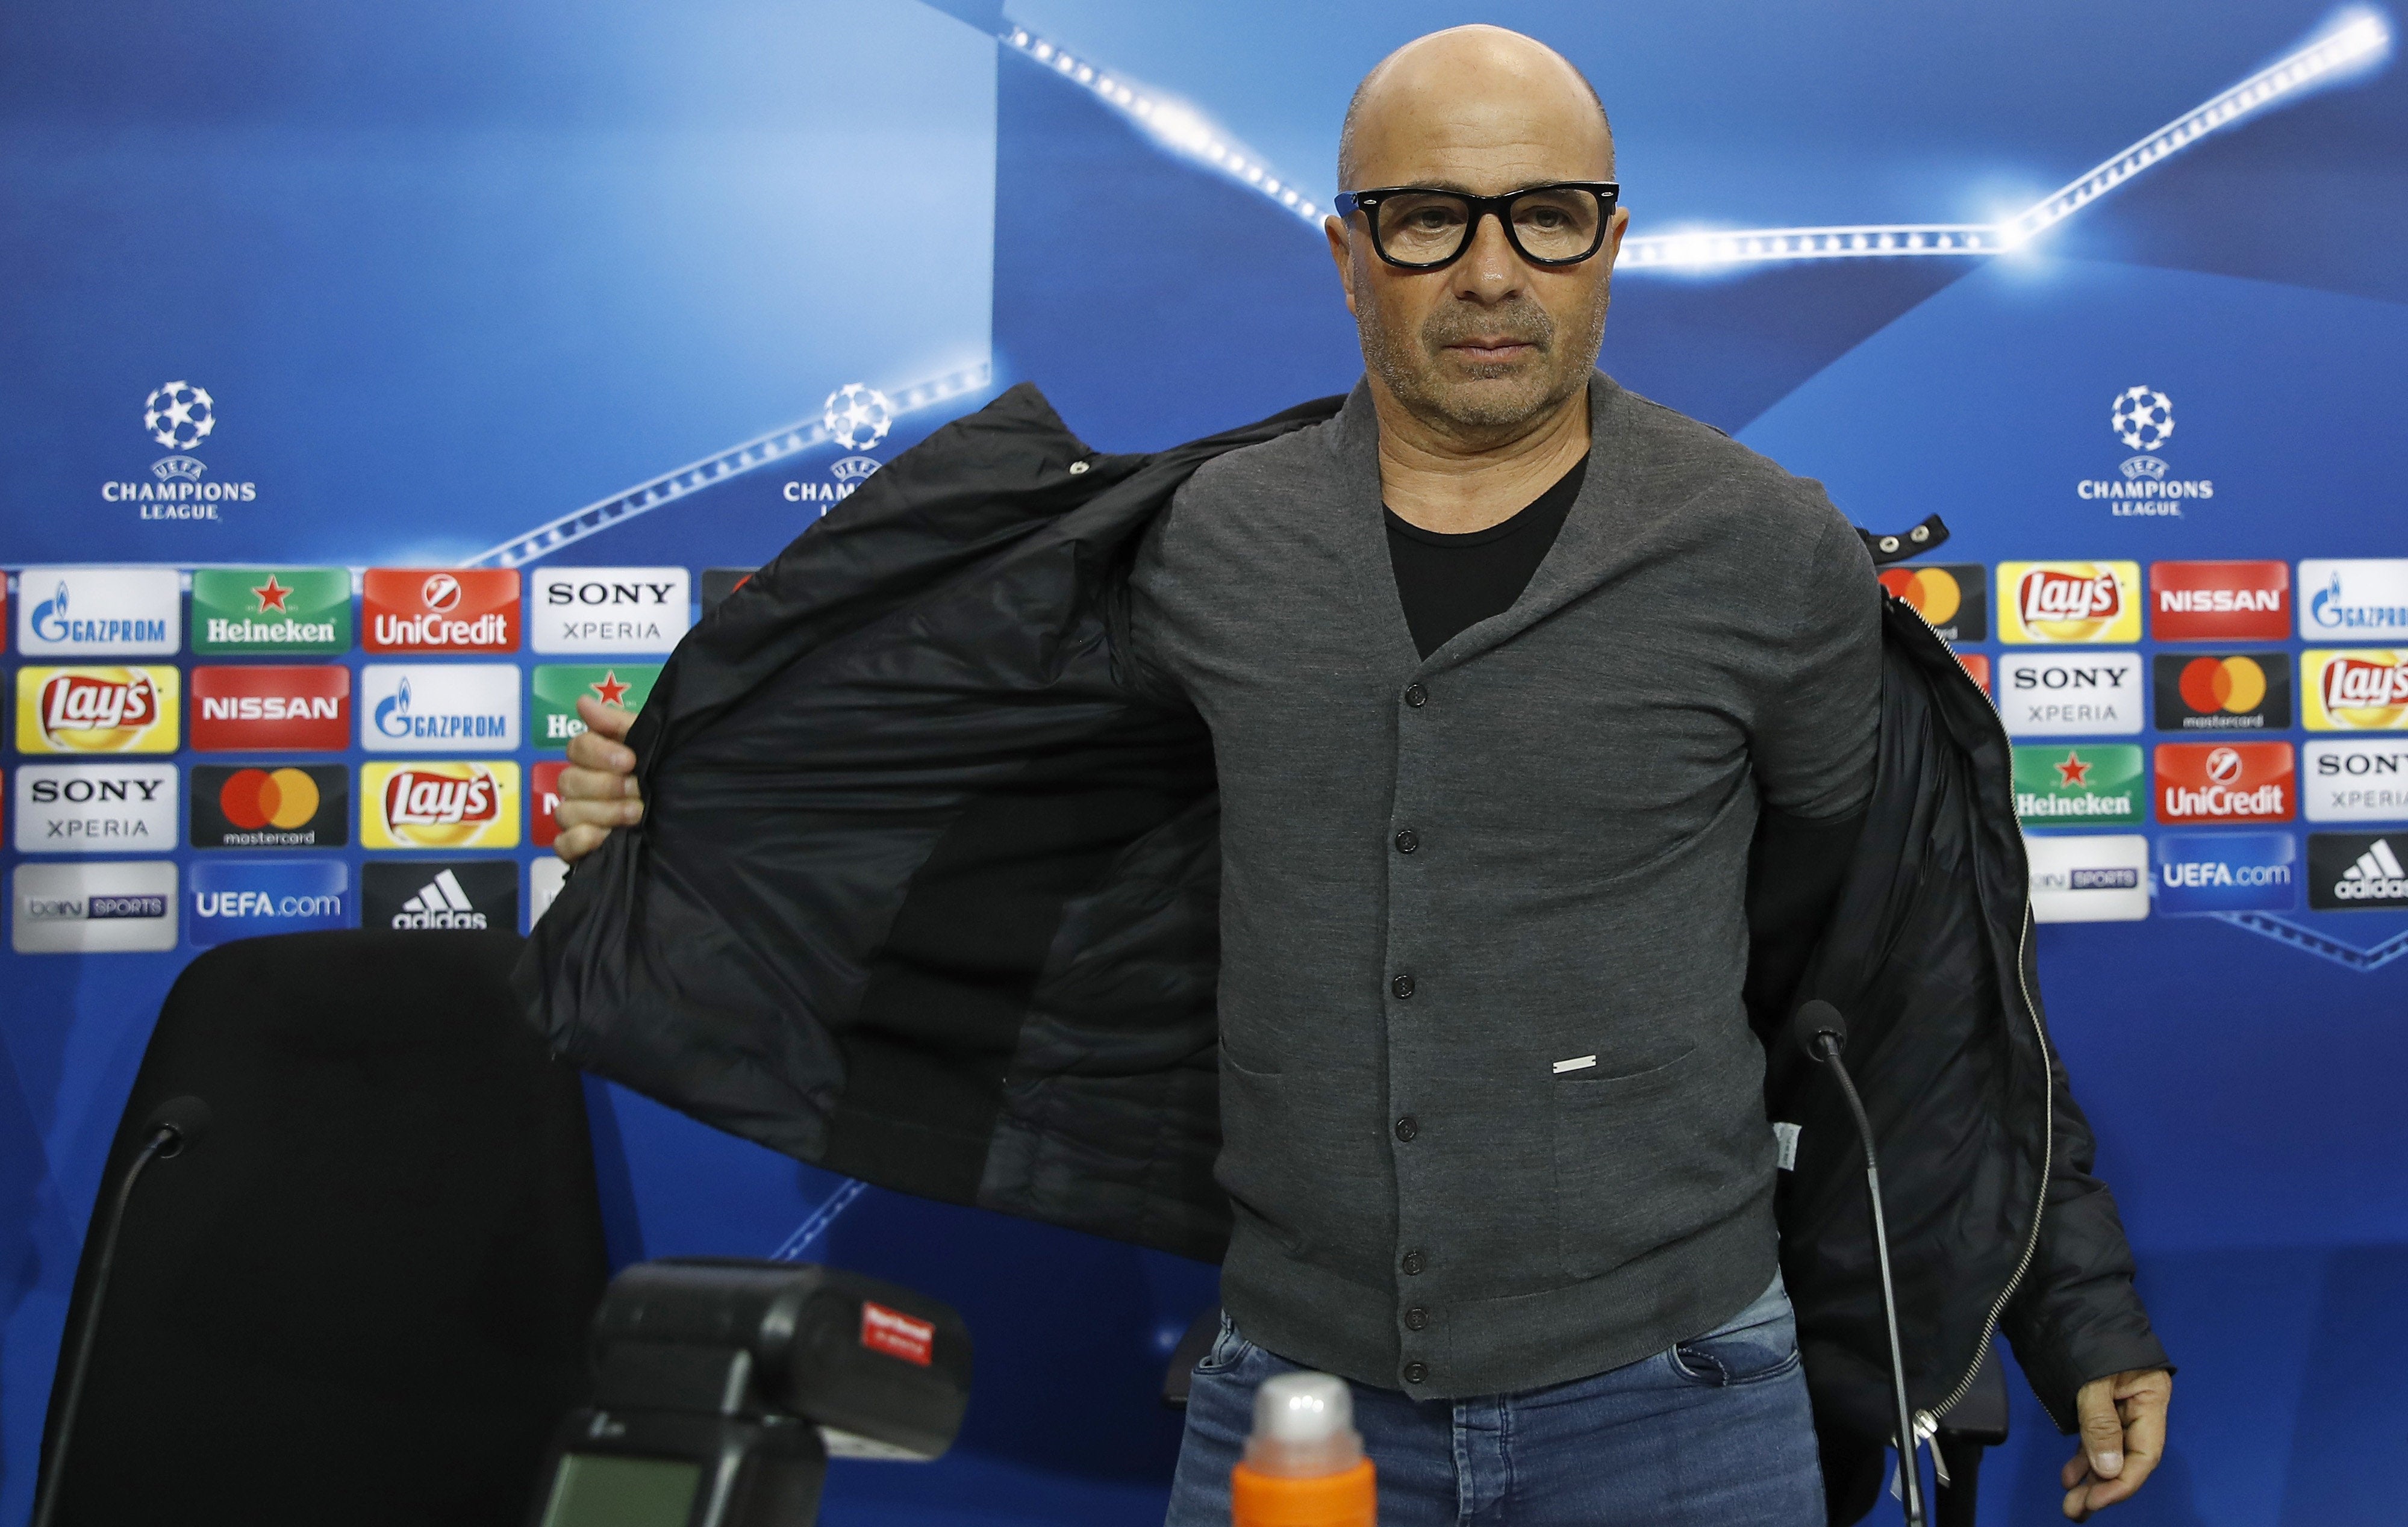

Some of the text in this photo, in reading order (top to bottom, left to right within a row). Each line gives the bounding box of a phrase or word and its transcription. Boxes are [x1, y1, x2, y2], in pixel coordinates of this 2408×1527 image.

[154, 460, 203, 480] UEFA
[2122, 461, 2166, 479] UEFA
[101, 480, 257, 502] CHAMPIONS
[2077, 479, 2213, 499] CHAMPIONS
[140, 503, 219, 520] LEAGUE
[2112, 501, 2180, 517] LEAGUE
[548, 582, 676, 606] SONY
[2024, 571, 2113, 621] Lay's
[2159, 589, 2280, 612] NISSAN
[72, 618, 166, 642] GAZPROM
[207, 618, 335, 643] Heineken
[375, 614, 507, 645] UniCredit
[563, 623, 661, 639] XPERIA
[2014, 668, 2130, 689] SONY
[48, 677, 148, 730] Lay's
[202, 696, 338, 720] NISSAN
[2028, 705, 2117, 722] XPERIA
[414, 715, 505, 738] GAZPROM
[2182, 713, 2265, 729] mastercard
[2318, 753, 2408, 776] SON
[31, 779, 164, 803] SONY
[391, 774, 490, 825] Lay's
[2165, 784, 2285, 816] UniCredit
[2018, 792, 2132, 816] Heineken
[47, 819, 149, 838] XPERIA
[223, 830, 315, 845] mastercard
[2073, 869, 2136, 888] SPORTS
[2163, 863, 2291, 888] UEFA.com
[93, 897, 162, 916] SPORTS
[196, 891, 342, 918] UEFA.com
[391, 908, 488, 930] adidas
